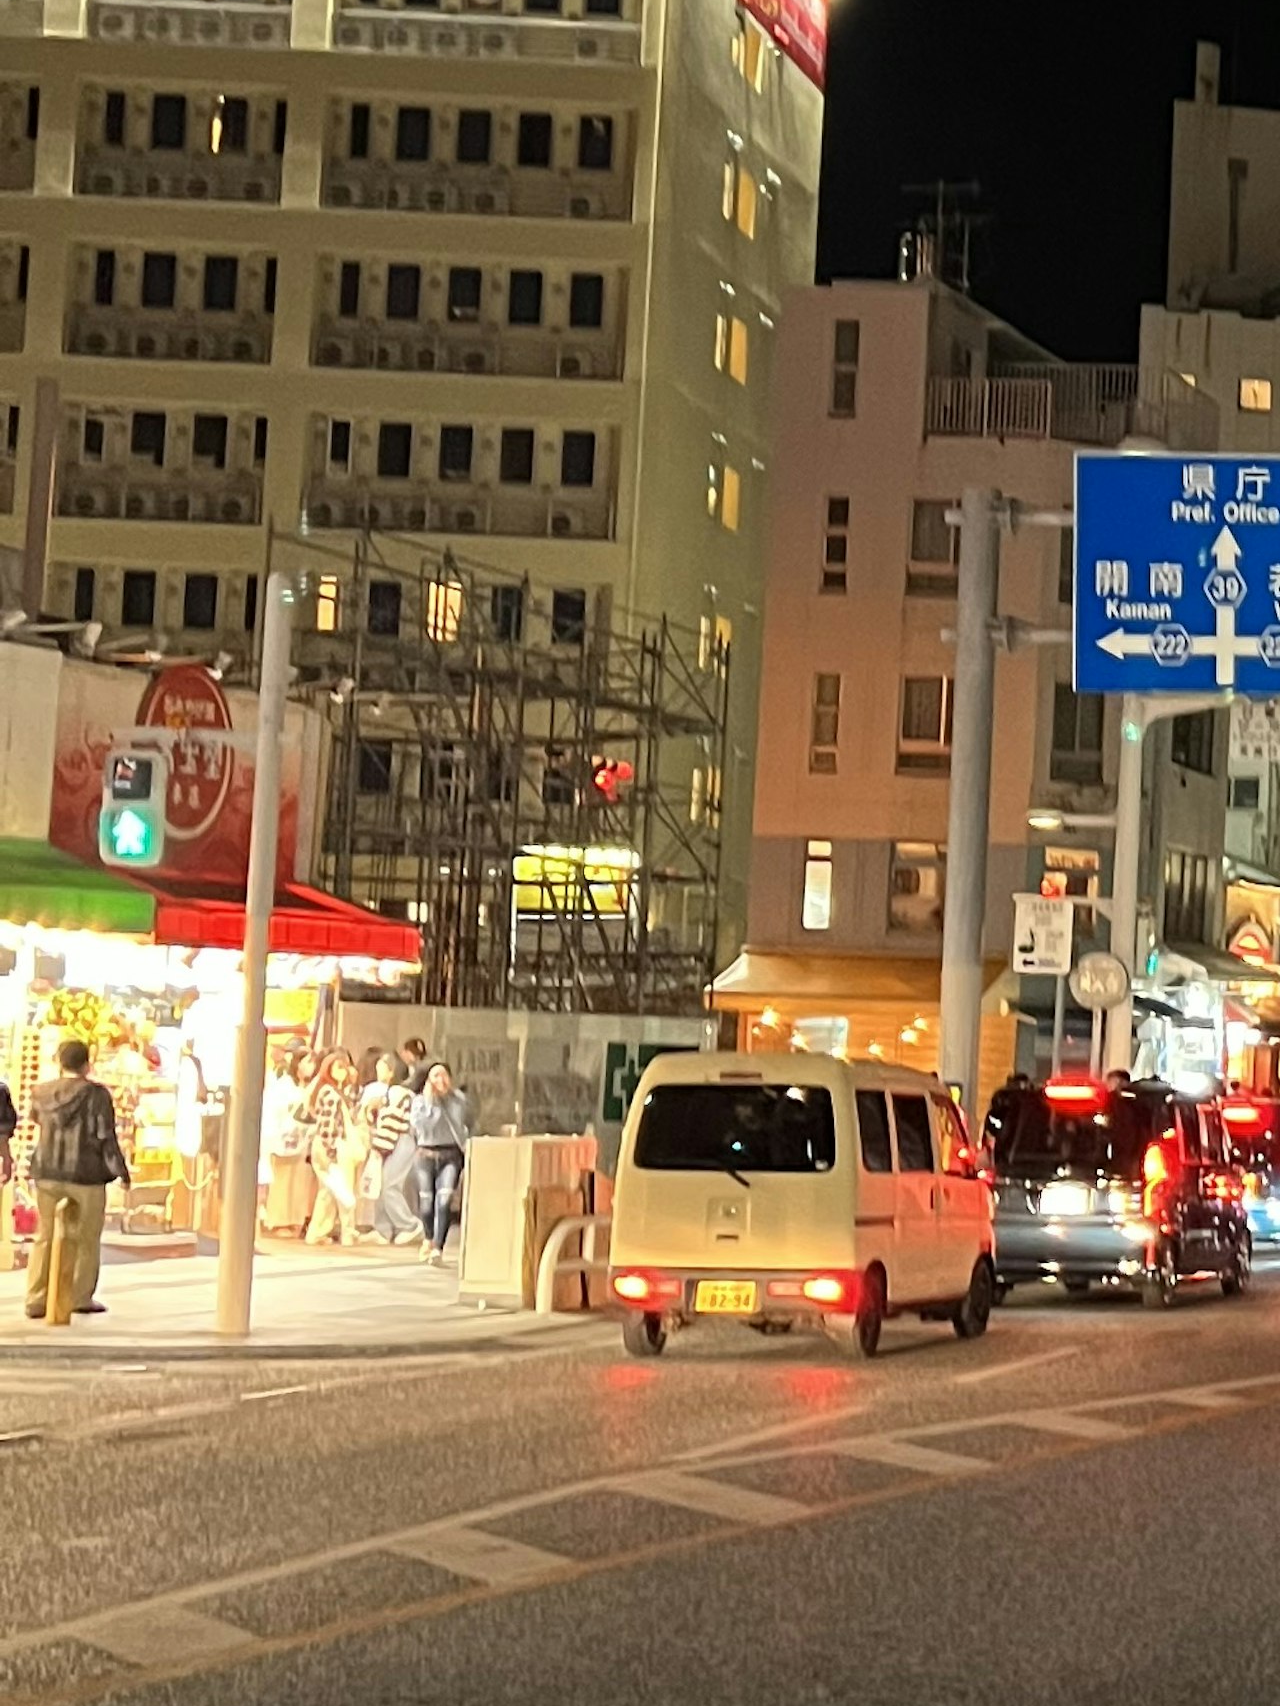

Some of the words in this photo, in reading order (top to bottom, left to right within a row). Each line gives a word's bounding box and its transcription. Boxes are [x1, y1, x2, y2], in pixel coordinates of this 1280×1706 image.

[1182, 464, 1271, 501] 県庁
[1171, 500, 1216, 523] Pref.
[1222, 500, 1280, 524] Office
[1095, 560, 1184, 598] 開南
[1211, 576, 1239, 598] 39
[1105, 599, 1172, 620] Kainan
[1154, 634, 1186, 654] 222
